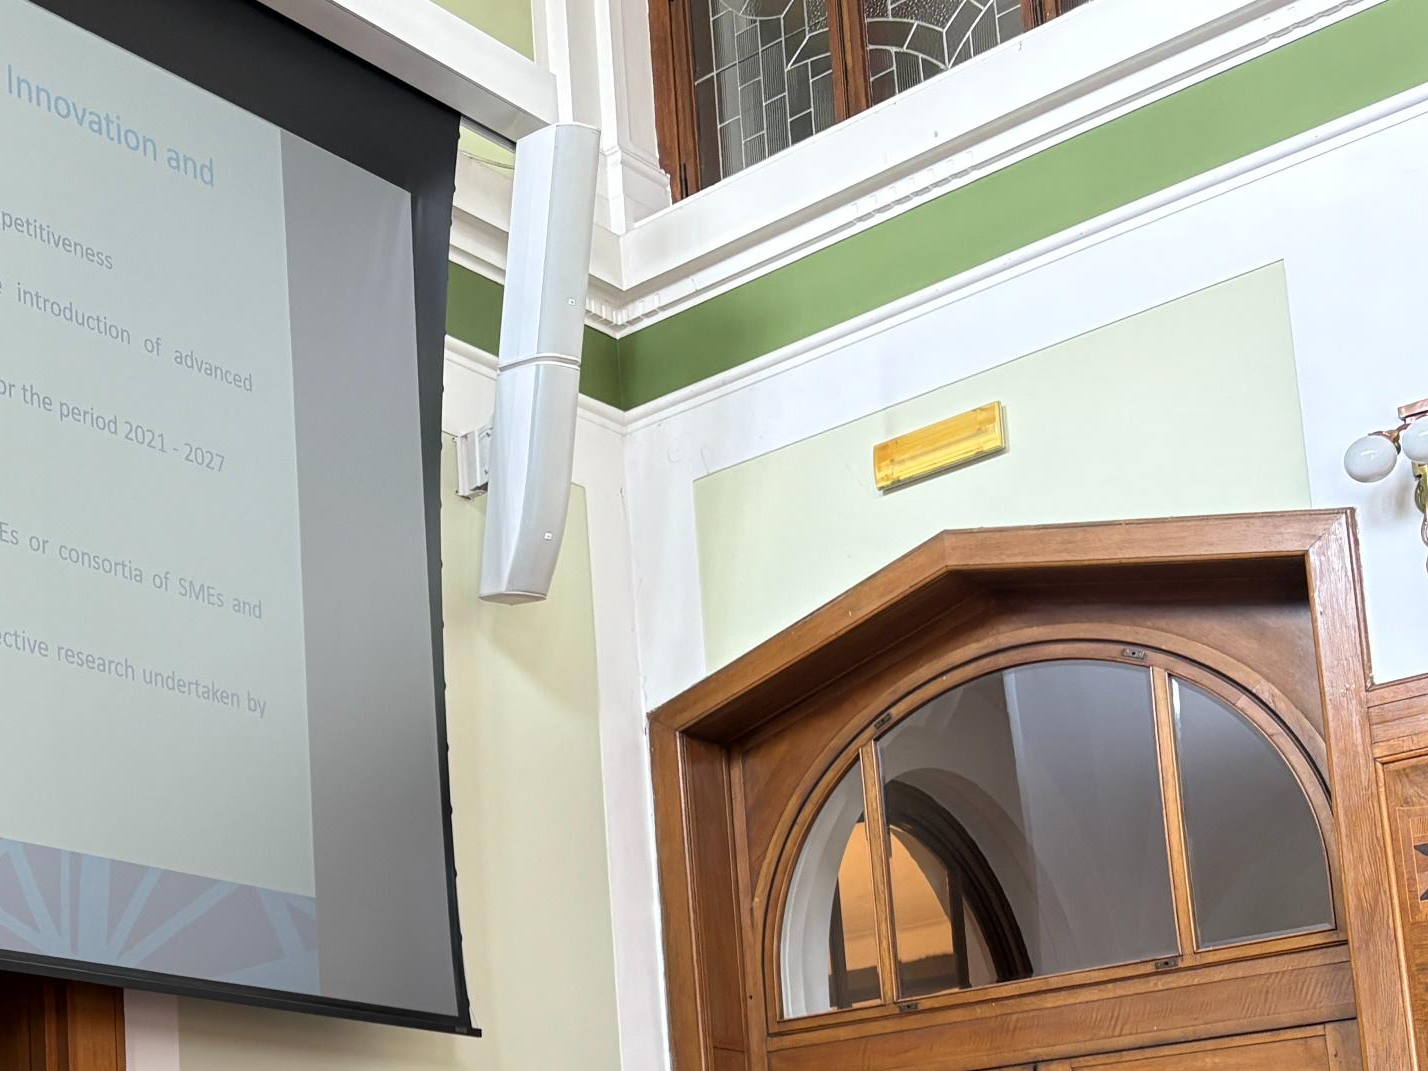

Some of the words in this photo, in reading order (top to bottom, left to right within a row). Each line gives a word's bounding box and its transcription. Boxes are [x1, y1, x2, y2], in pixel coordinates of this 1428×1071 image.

[7, 63, 158, 162] Innovation
[166, 147, 215, 189] and
[16, 280, 131, 345] introduction
[143, 336, 163, 357] of
[173, 349, 253, 393] advanced
[20, 383, 53, 413] the
[59, 400, 118, 437] period
[123, 420, 168, 454] 2021
[183, 442, 225, 473] 2027
[28, 535, 50, 555] or
[58, 544, 144, 585] consortia
[152, 570, 171, 593] of
[178, 577, 225, 608] SMEs
[232, 597, 263, 620] and
[56, 645, 135, 681] research
[142, 668, 241, 709] undertaken
[247, 690, 267, 720] by
